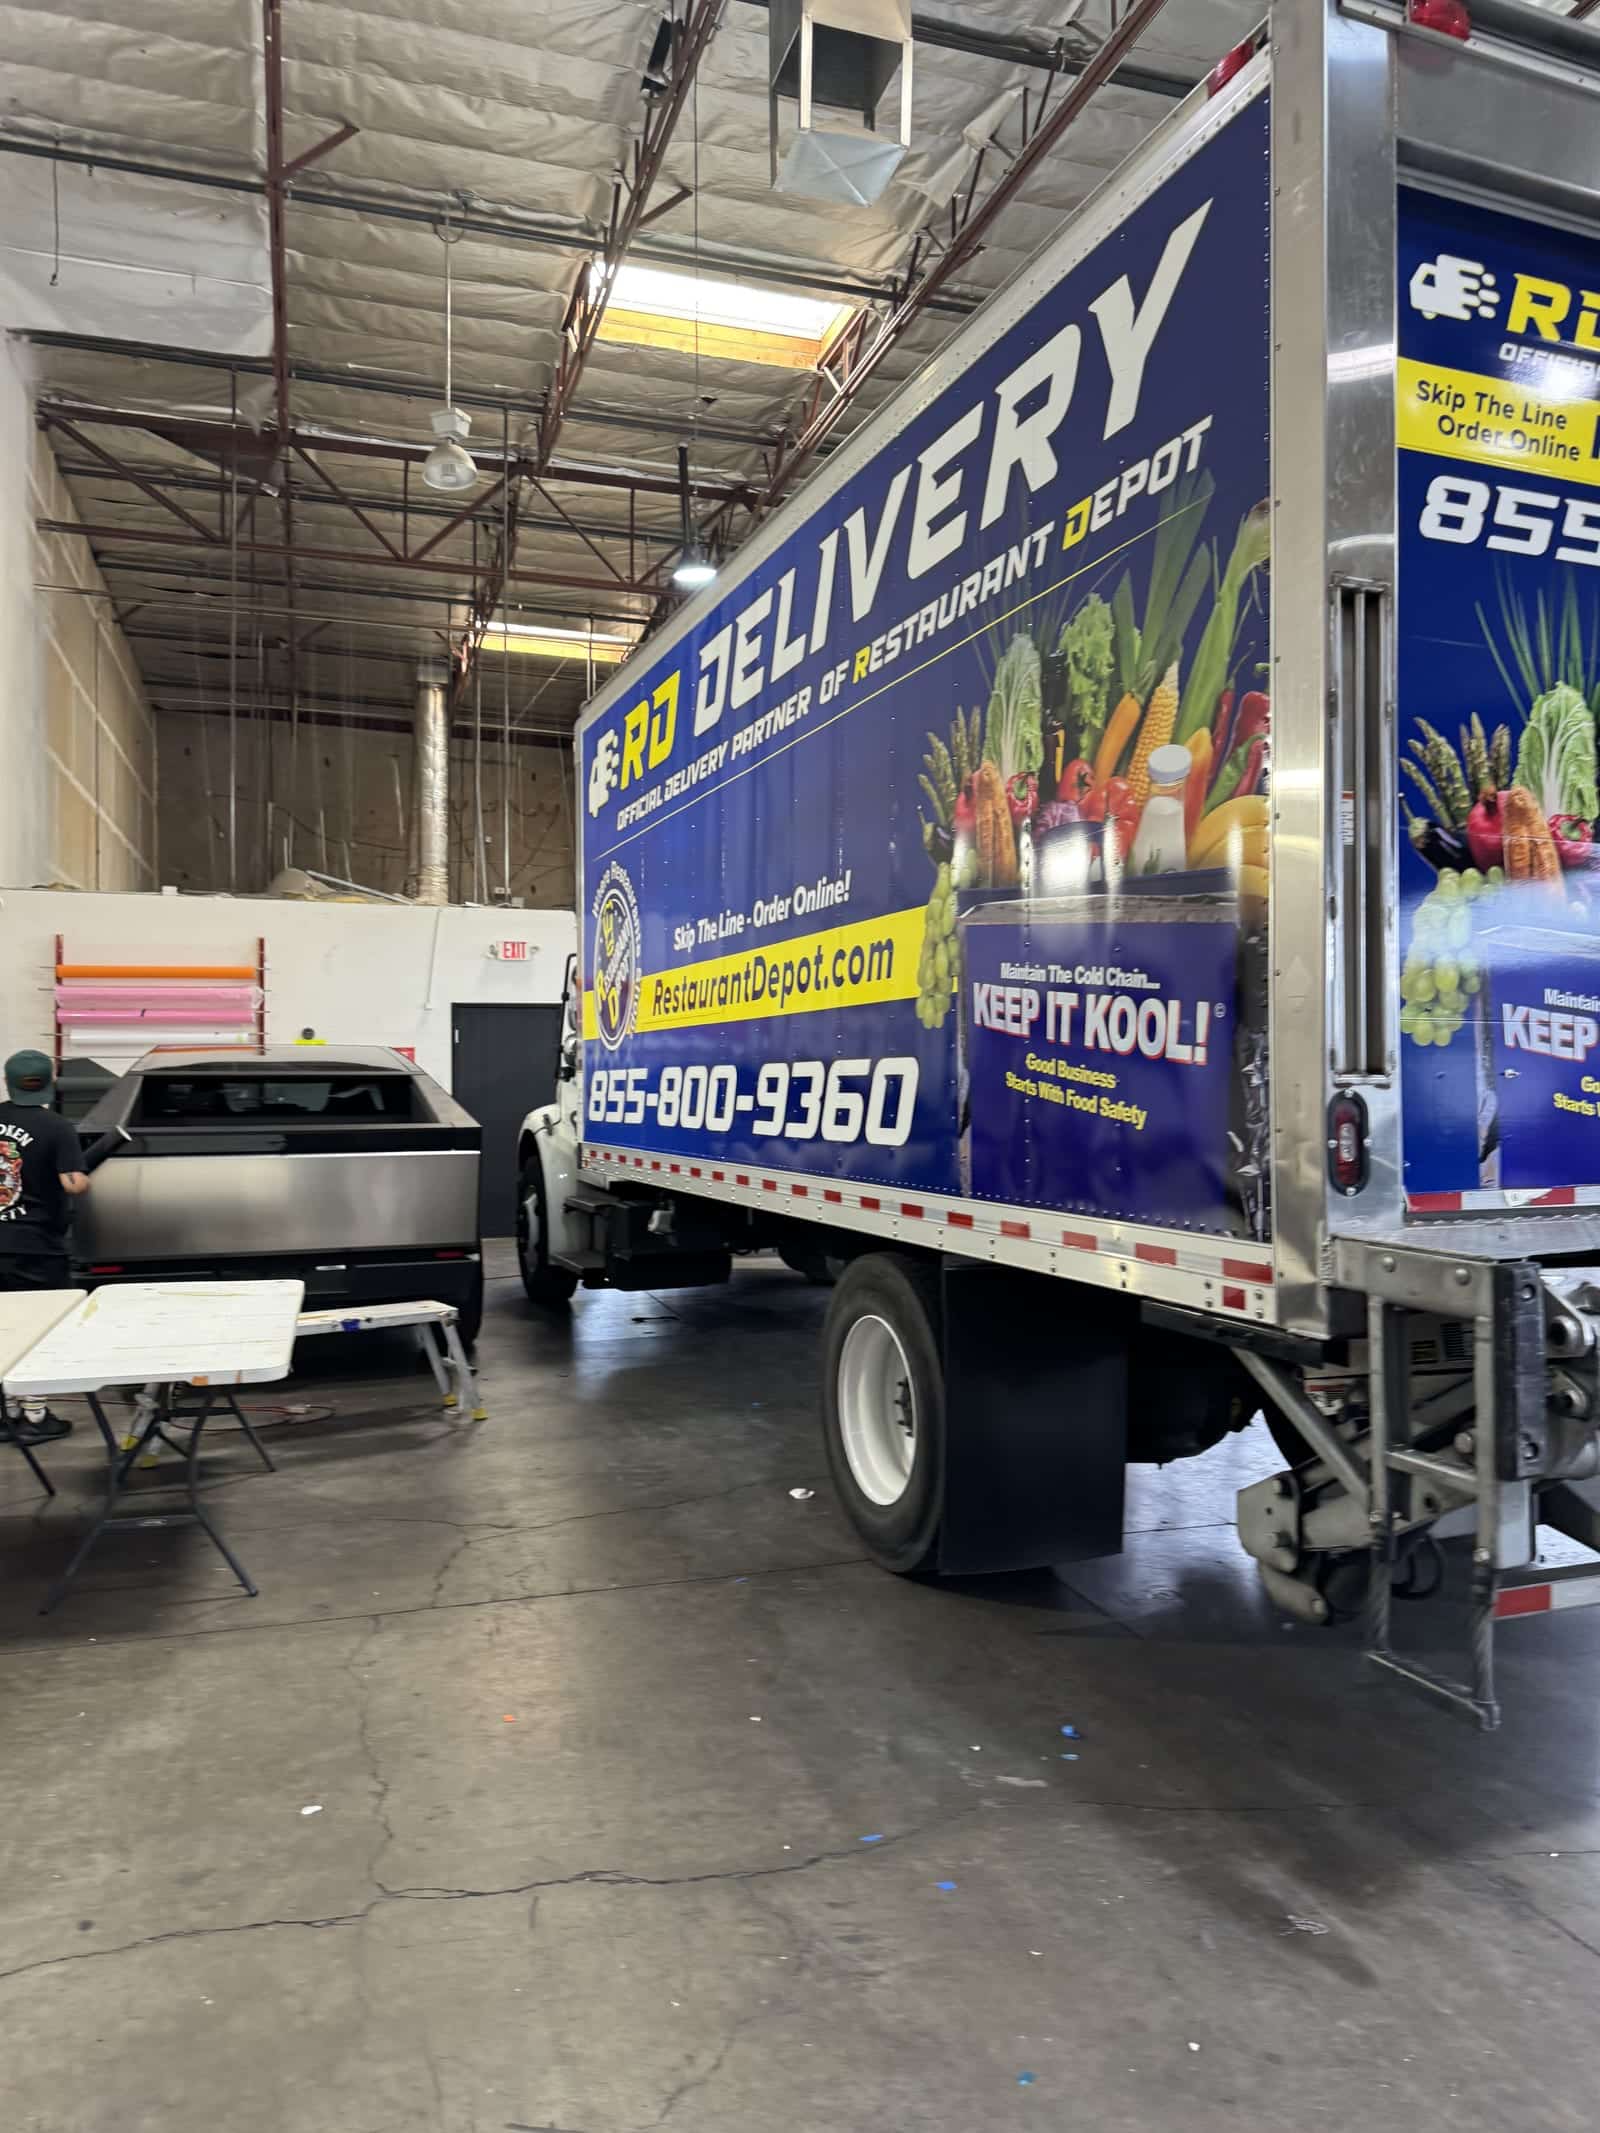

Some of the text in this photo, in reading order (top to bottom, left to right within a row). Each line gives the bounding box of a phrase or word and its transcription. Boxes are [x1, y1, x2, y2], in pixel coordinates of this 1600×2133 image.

[1416, 379, 1567, 430] Skip The Line
[1437, 414, 1503, 447] Order
[1511, 429, 1580, 461] Online
[620, 198, 1214, 790] RD DELIVERY
[617, 414, 1214, 831] OFFICIAL DELIVERY PARTNER OF RESTAURANT DEPOT
[673, 923, 695, 953] Skip
[697, 917, 717, 944] The
[718, 909, 745, 938] Line
[753, 894, 791, 928] Order
[793, 870, 851, 916] Online!
[503, 941, 528, 959] EXIT
[652, 937, 894, 1017] RestaurantDepot.com
[1000, 962, 1046, 982] Maintain
[1048, 964, 1072, 984] The
[1073, 965, 1104, 987] Cold
[973, 982, 1211, 1066] KEEP IT KOOL!
[1502, 1003, 1598, 1063] KEEP
[1005, 1071, 1147, 1131] Starts With Food Safety
[1025, 1053, 1117, 1089] Good Business
[588, 1057, 919, 1146] 855-800-9360
[1553, 1092, 1596, 1116] Starts
